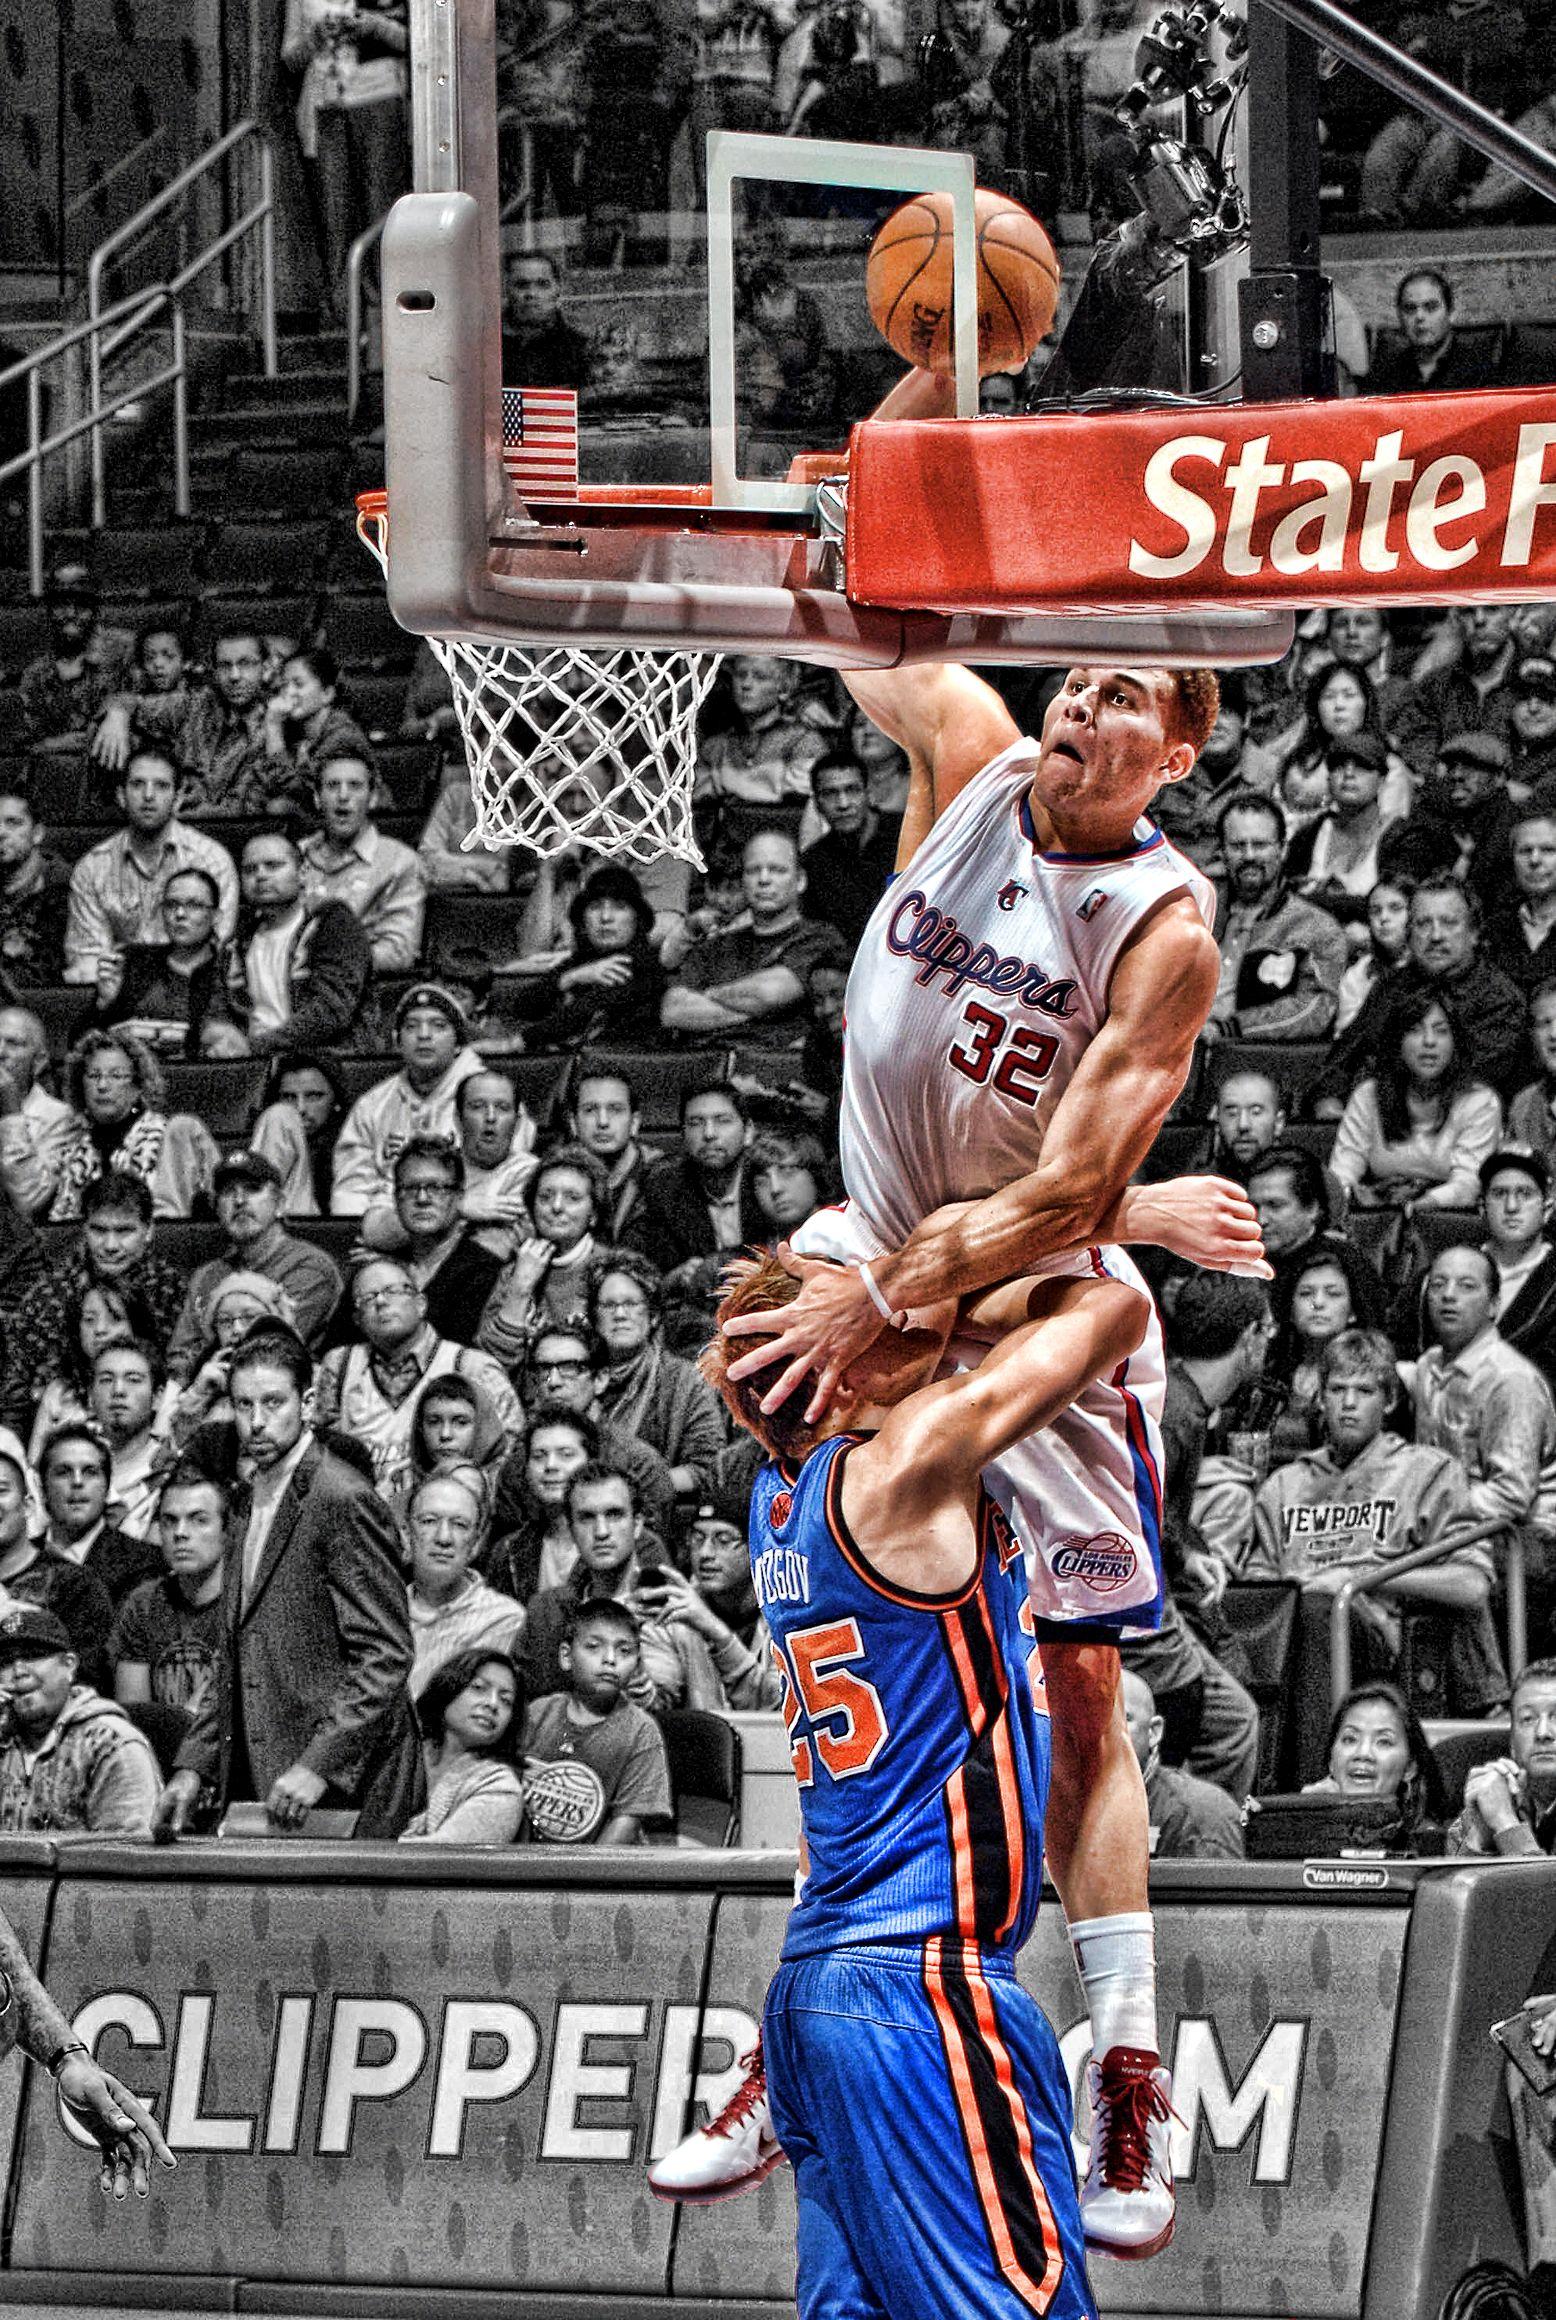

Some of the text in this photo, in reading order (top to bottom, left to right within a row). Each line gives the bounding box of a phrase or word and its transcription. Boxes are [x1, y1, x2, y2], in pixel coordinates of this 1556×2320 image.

[1128, 429, 1487, 580] State
[886, 889, 1079, 1020] Clippers
[948, 1001, 1061, 1108] 32
[1051, 1547, 1131, 1578] CLIPPERS
[771, 1616, 889, 1787] 25
[1313, 1869, 1380, 1885] Van Wagner
